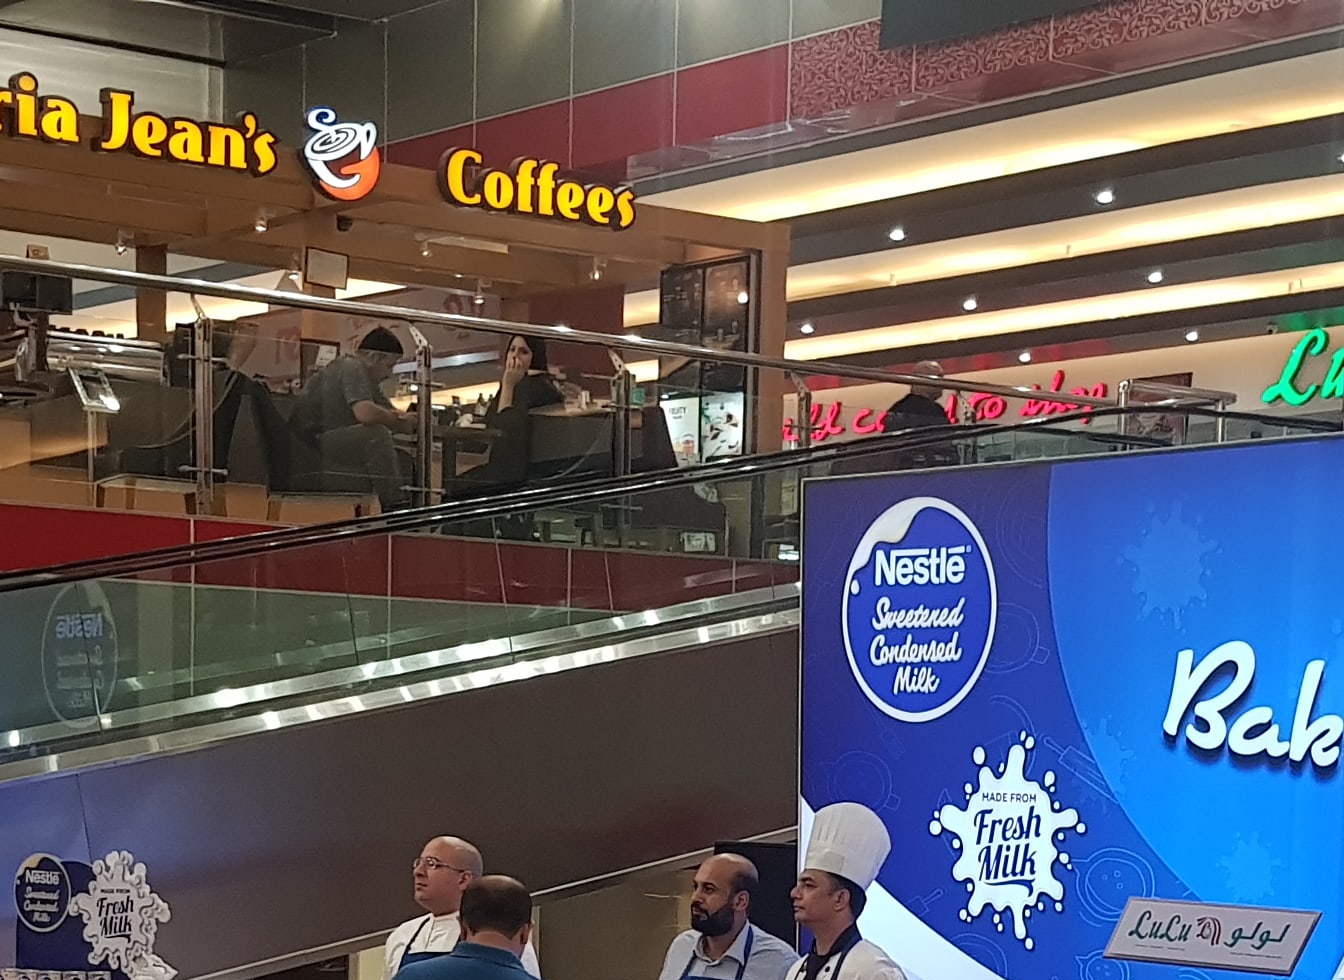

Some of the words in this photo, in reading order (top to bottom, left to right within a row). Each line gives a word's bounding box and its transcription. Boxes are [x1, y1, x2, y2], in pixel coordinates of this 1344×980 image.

[100, 88, 275, 174] Jean's
[445, 149, 635, 229] Coffees
[871, 597, 966, 630] Sweetened
[870, 631, 962, 666] Condensed
[893, 665, 940, 695] Milk
[982, 792, 1008, 802] MADE
[1010, 793, 1037, 803] FROM
[973, 805, 1041, 845] Fresh
[978, 843, 1037, 881] Milk
[97, 895, 134, 918] Fresh
[100, 916, 133, 937] Milk
[1128, 910, 1192, 942] LuLu
[1224, 921, 1292, 951] لولو
